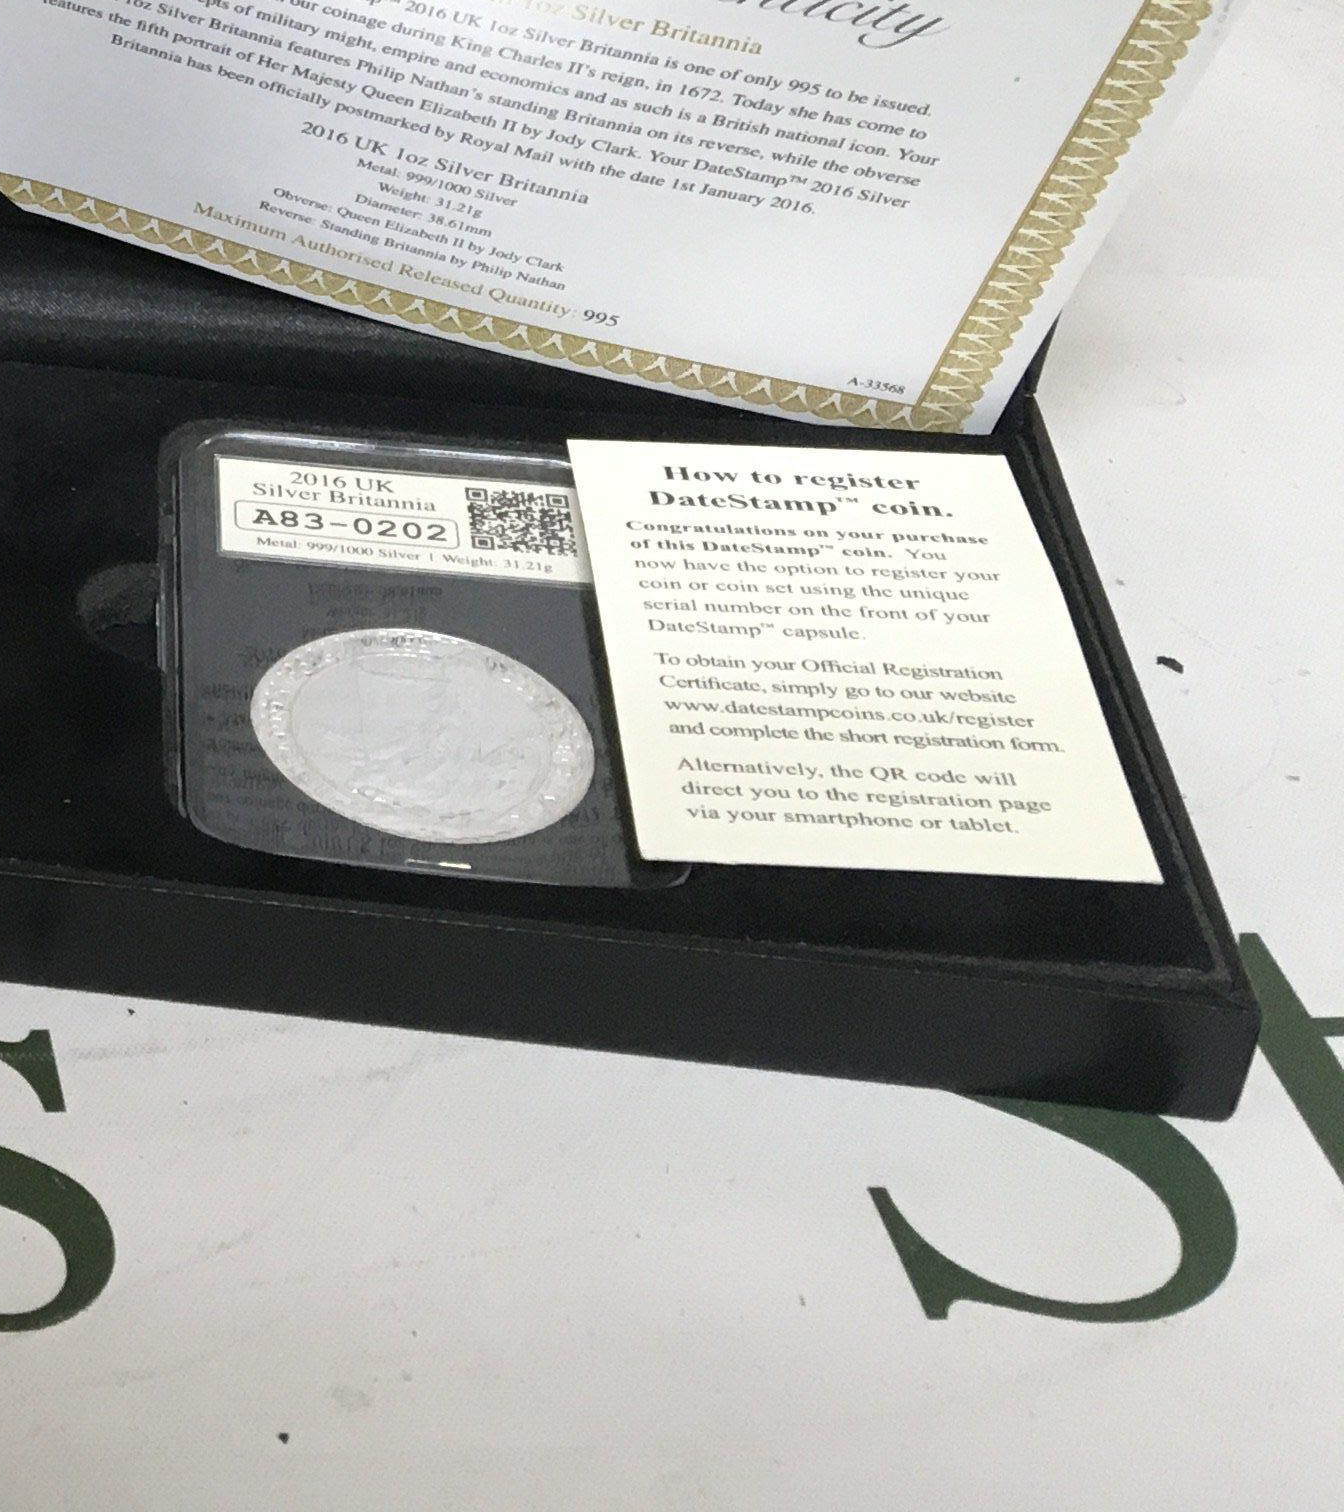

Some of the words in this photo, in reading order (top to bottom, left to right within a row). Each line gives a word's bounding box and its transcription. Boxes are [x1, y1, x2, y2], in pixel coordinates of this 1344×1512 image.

[156, 2, 206, 26] Silver
[207, 16, 283, 49] Britannia
[286, 40, 352, 68] features
[355, 58, 406, 84] Philip
[486, 94, 560, 121] standing
[563, 108, 643, 136] Britannia
[646, 128, 670, 141] on
[672, 130, 694, 146] its
[697, 138, 765, 161] reverse,
[771, 151, 819, 169] while
[821, 159, 850, 175] the
[852, 165, 922, 187] obverse
[110, 33, 183, 65] Britannia
[185, 55, 213, 73] has
[216, 64, 256, 87] been
[257, 79, 332, 110] officially
[333, 101, 432, 135] postmarked
[433, 125, 456, 143] by
[458, 131, 511, 154] Royal
[512, 144, 555, 164] Mail
[558, 156, 596, 174] with
[599, 164, 627, 179] the
[629, 170, 666, 187] date
[671, 177, 697, 193] 1st
[698, 182, 766, 208] January
[769, 195, 815, 215] 2016.
[300, 120, 349, 145] 2016
[354, 135, 389, 157] UK
[396, 147, 430, 168] 1oz
[433, 157, 495, 183] Silver
[497, 172, 590, 205] Britannia
[356, 157, 404, 179] Metal:
[405, 171, 473, 196] 999/1000
[473, 188, 519, 208] Silver
[354, 192, 423, 219] Diameter:
[427, 212, 493, 238] 38.61mm
[378, 181, 431, 204] Weight:
[434, 196, 484, 220] 31.21g
[192, 201, 287, 242] Maximum
[290, 234, 395, 273] Authorised
[397, 262, 485, 297] Released
[487, 287, 576, 319] Quantity:
[583, 309, 621, 327] 995
[290, 470, 348, 489] 2016
[354, 476, 395, 494] UK
[663, 465, 738, 483] How
[750, 470, 783, 485] to
[793, 472, 921, 491] register
[252, 482, 321, 502] Silver
[329, 489, 437, 513] Britannia
[871, 500, 954, 518] coin.
[251, 508, 448, 543] A83-0202
[625, 520, 798, 539] Congratulations
[804, 526, 830, 539] on
[835, 530, 885, 541] your
[891, 532, 989, 546] purchase
[256, 536, 302, 550] Metal:
[305, 541, 375, 558] 999/1000
[377, 546, 422, 562] Silver
[441, 553, 498, 569] Weight:
[503, 558, 554, 575] 31.21g
[653, 651, 682, 666] To
[685, 653, 747, 669] obtain
[750, 659, 797, 674] your
[800, 659, 877, 675] Official
[881, 661, 1004, 682] Registration
[677, 756, 824, 781] Alternatively,
[829, 763, 864, 780] the
[869, 766, 908, 783] QR
[914, 769, 967, 785] code
[973, 771, 1018, 787] will
[685, 804, 721, 820] via
[725, 809, 777, 825] your
[783, 811, 914, 829] smartphone
[919, 818, 944, 830] or
[948, 816, 1020, 834] tablet.
